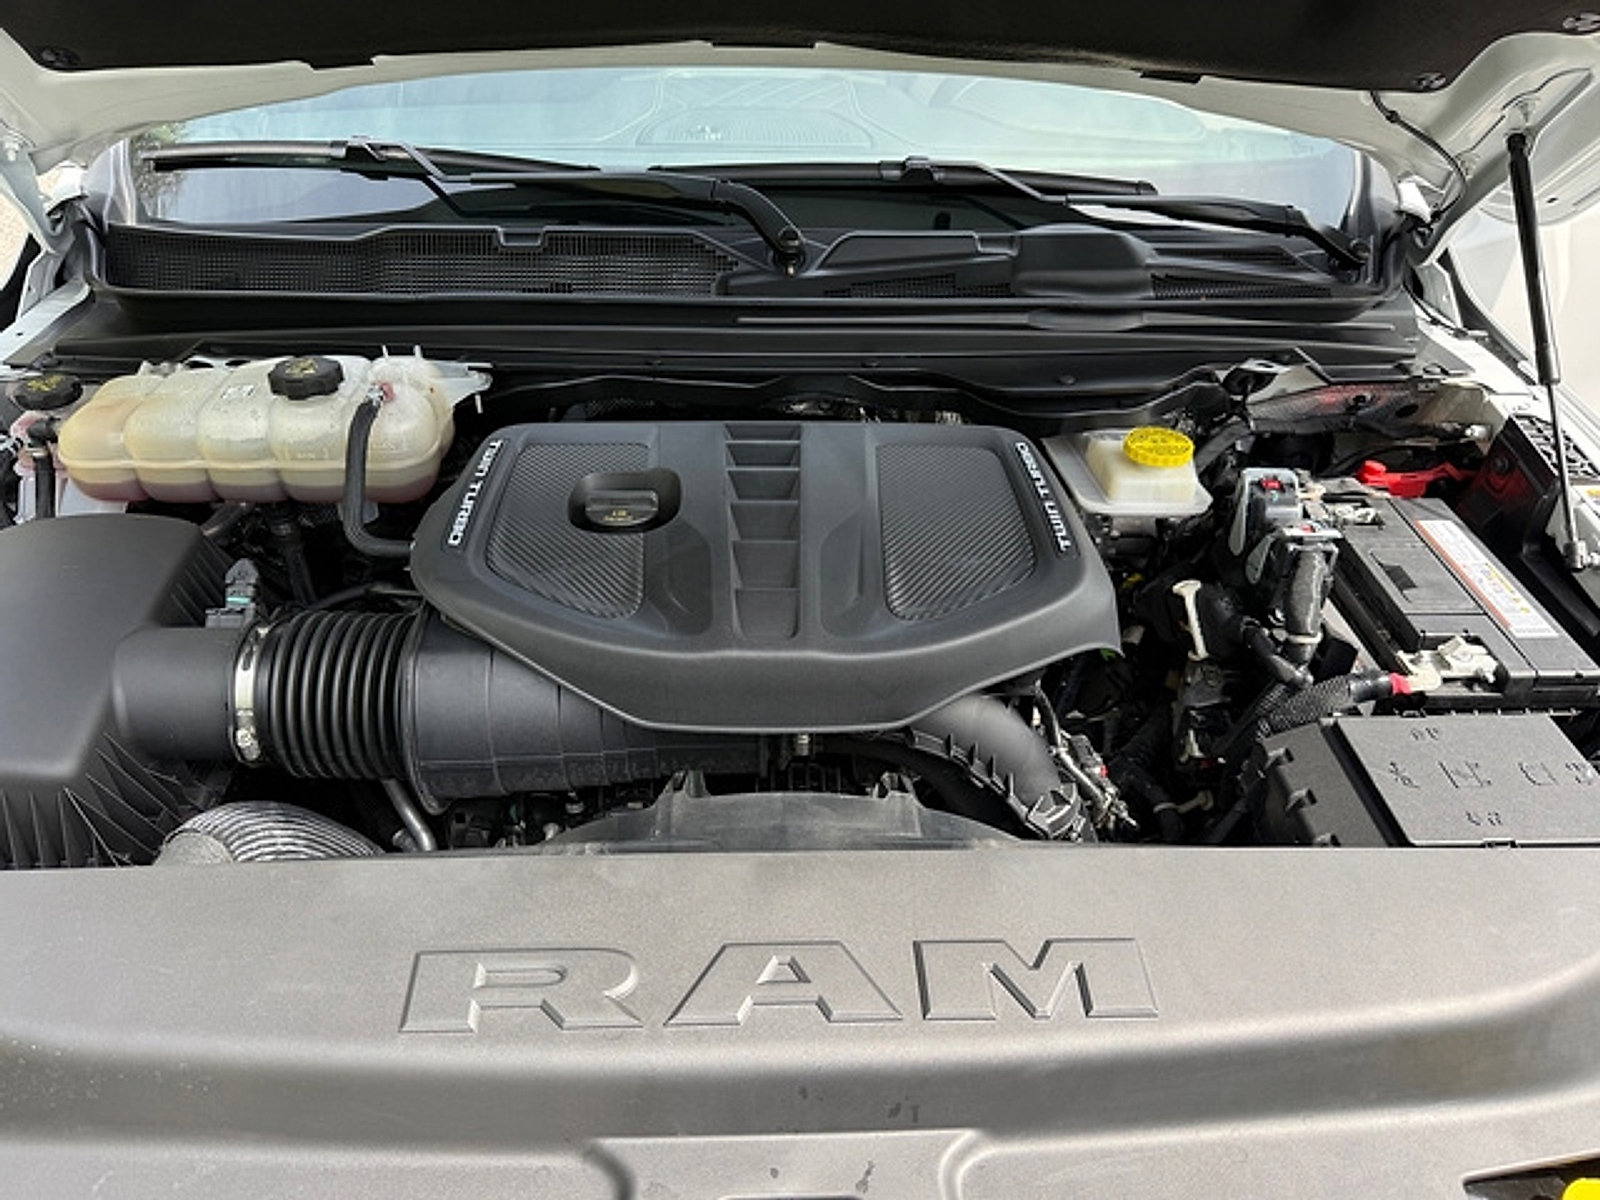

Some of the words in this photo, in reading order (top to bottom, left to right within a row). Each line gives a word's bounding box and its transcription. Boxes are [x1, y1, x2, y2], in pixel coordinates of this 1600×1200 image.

[1016, 441, 1050, 498] TURBO
[448, 481, 483, 546] TURBO
[1044, 501, 1072, 552] TWIN
[399, 938, 1160, 1034] RAM
